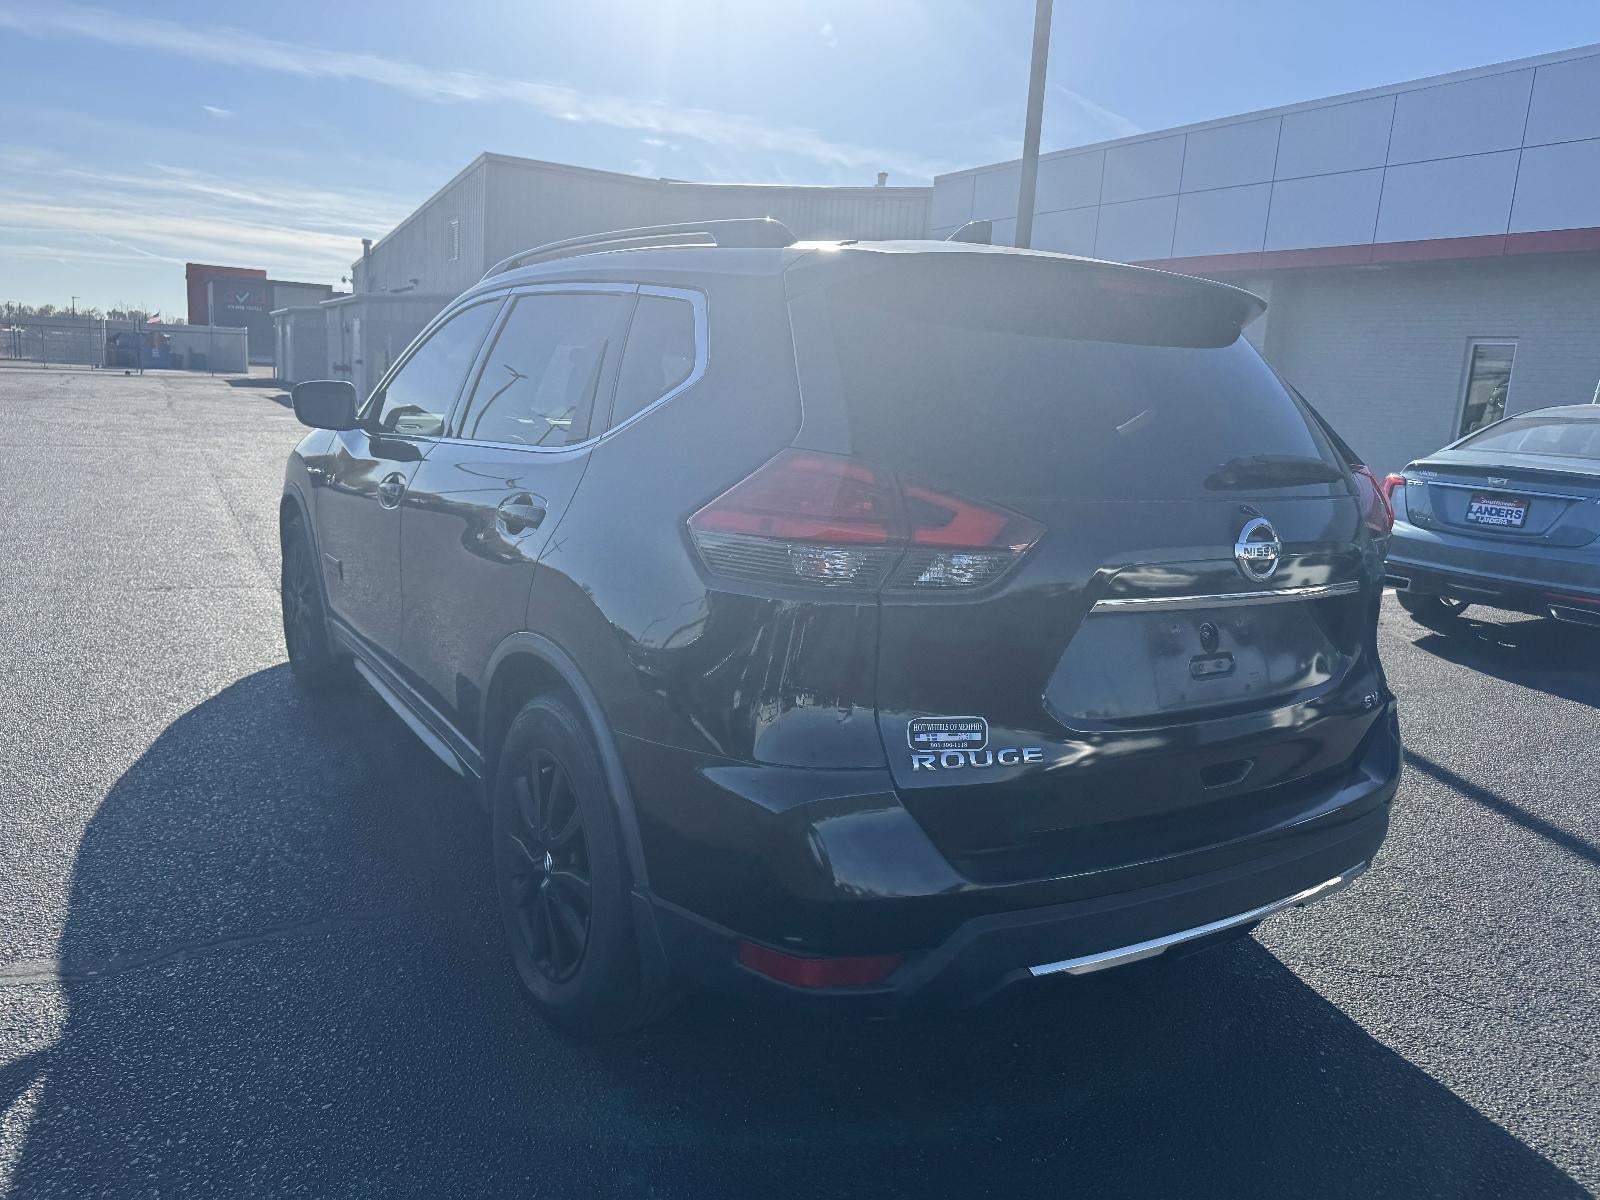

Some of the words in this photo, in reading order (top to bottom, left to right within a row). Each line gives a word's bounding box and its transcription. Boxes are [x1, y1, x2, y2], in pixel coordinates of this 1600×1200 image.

[1469, 503, 1522, 520] LANDERS
[1243, 547, 1277, 557] NISSA
[913, 723, 926, 732] HOT
[927, 723, 949, 731] WHEELS
[949, 723, 958, 731] OF
[958, 722, 983, 731] MEMPHIS
[910, 747, 1043, 771] ROUGE
